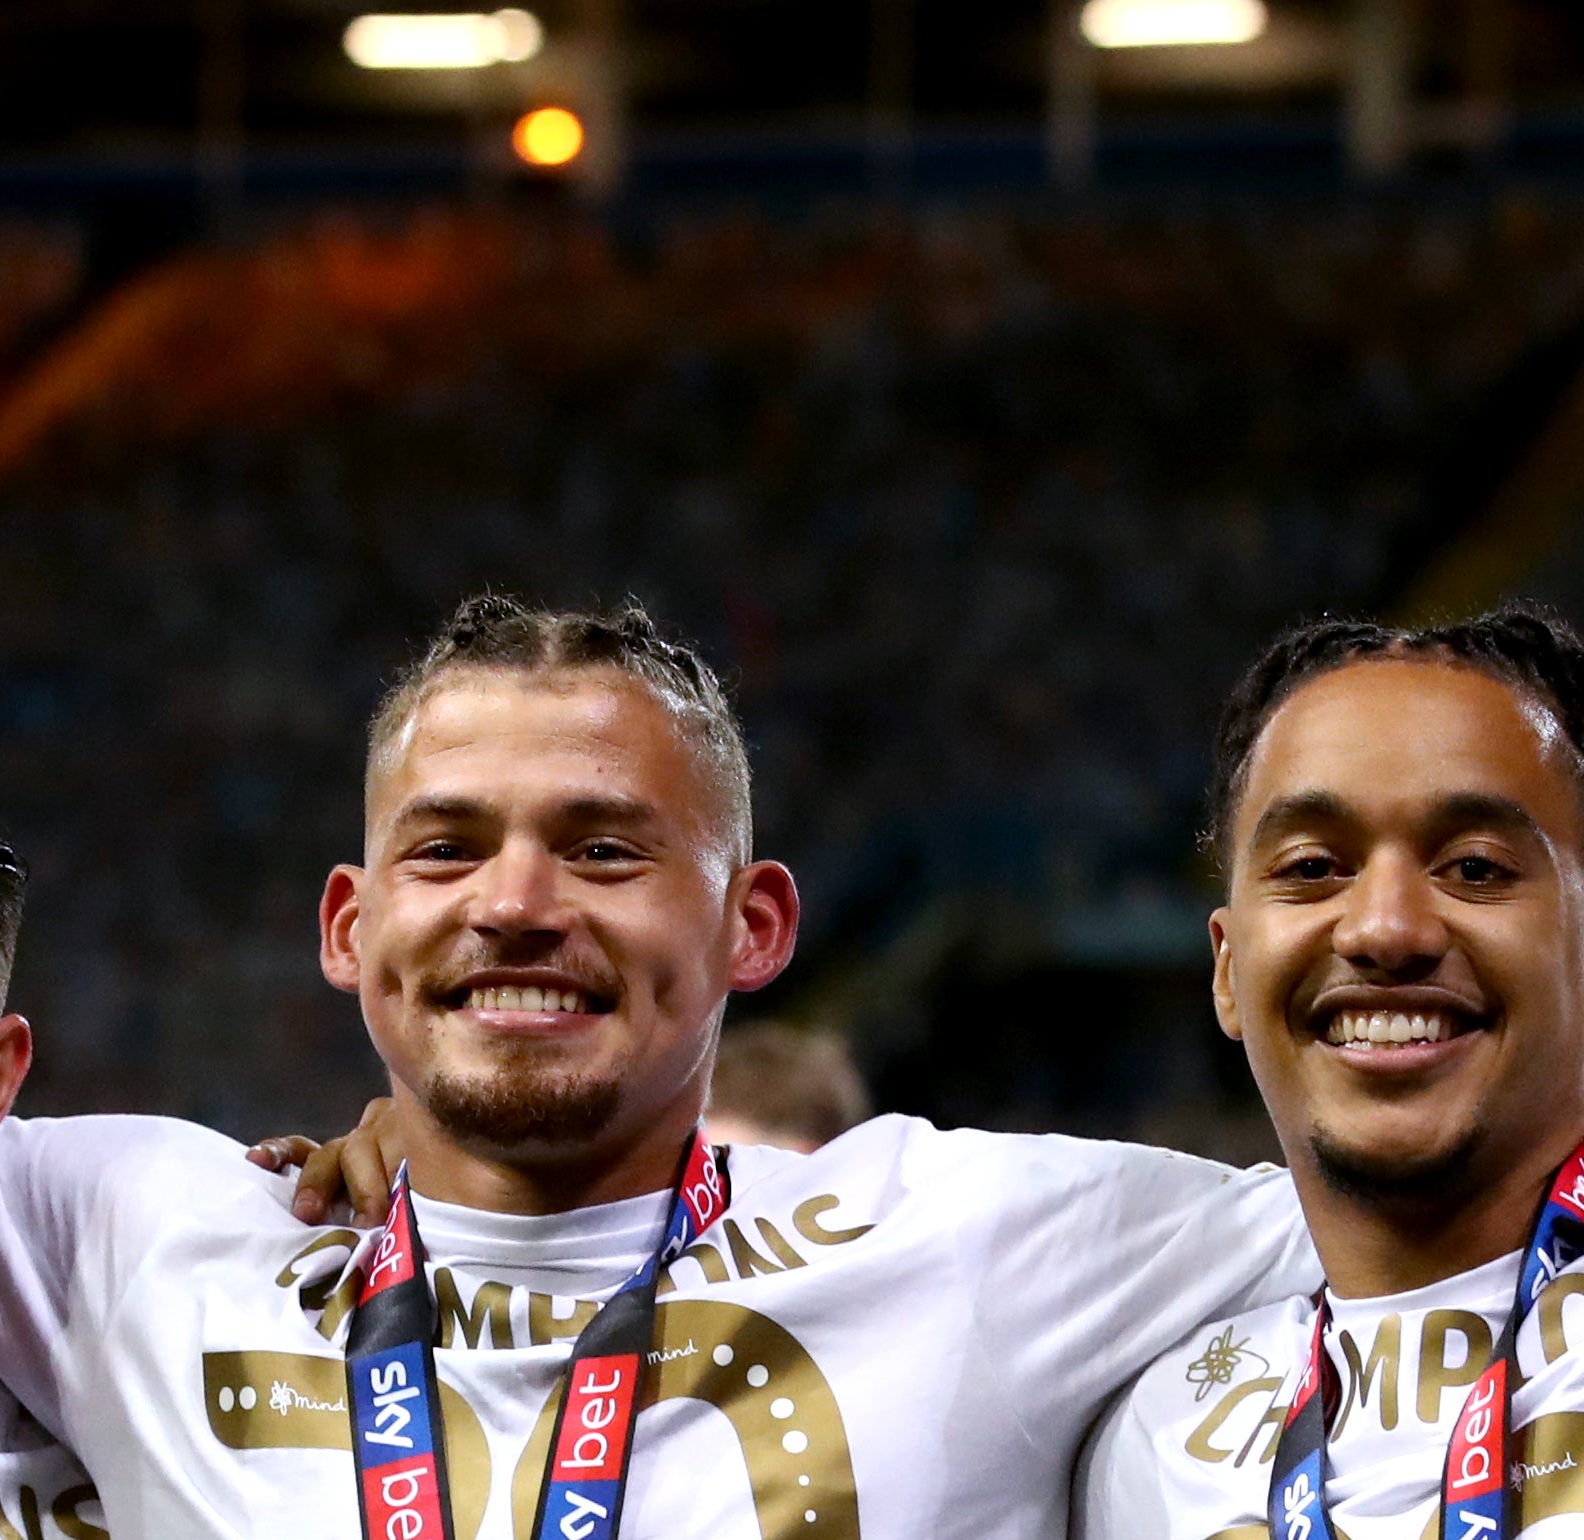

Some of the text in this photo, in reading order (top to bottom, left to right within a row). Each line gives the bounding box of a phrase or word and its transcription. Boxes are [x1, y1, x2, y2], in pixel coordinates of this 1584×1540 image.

[648, 1338, 699, 1366] mind
[364, 1361, 420, 1449] sky
[560, 1369, 621, 1468] bet
[1452, 1379, 1495, 1489] bet
[1524, 1451, 1578, 1481] mind
